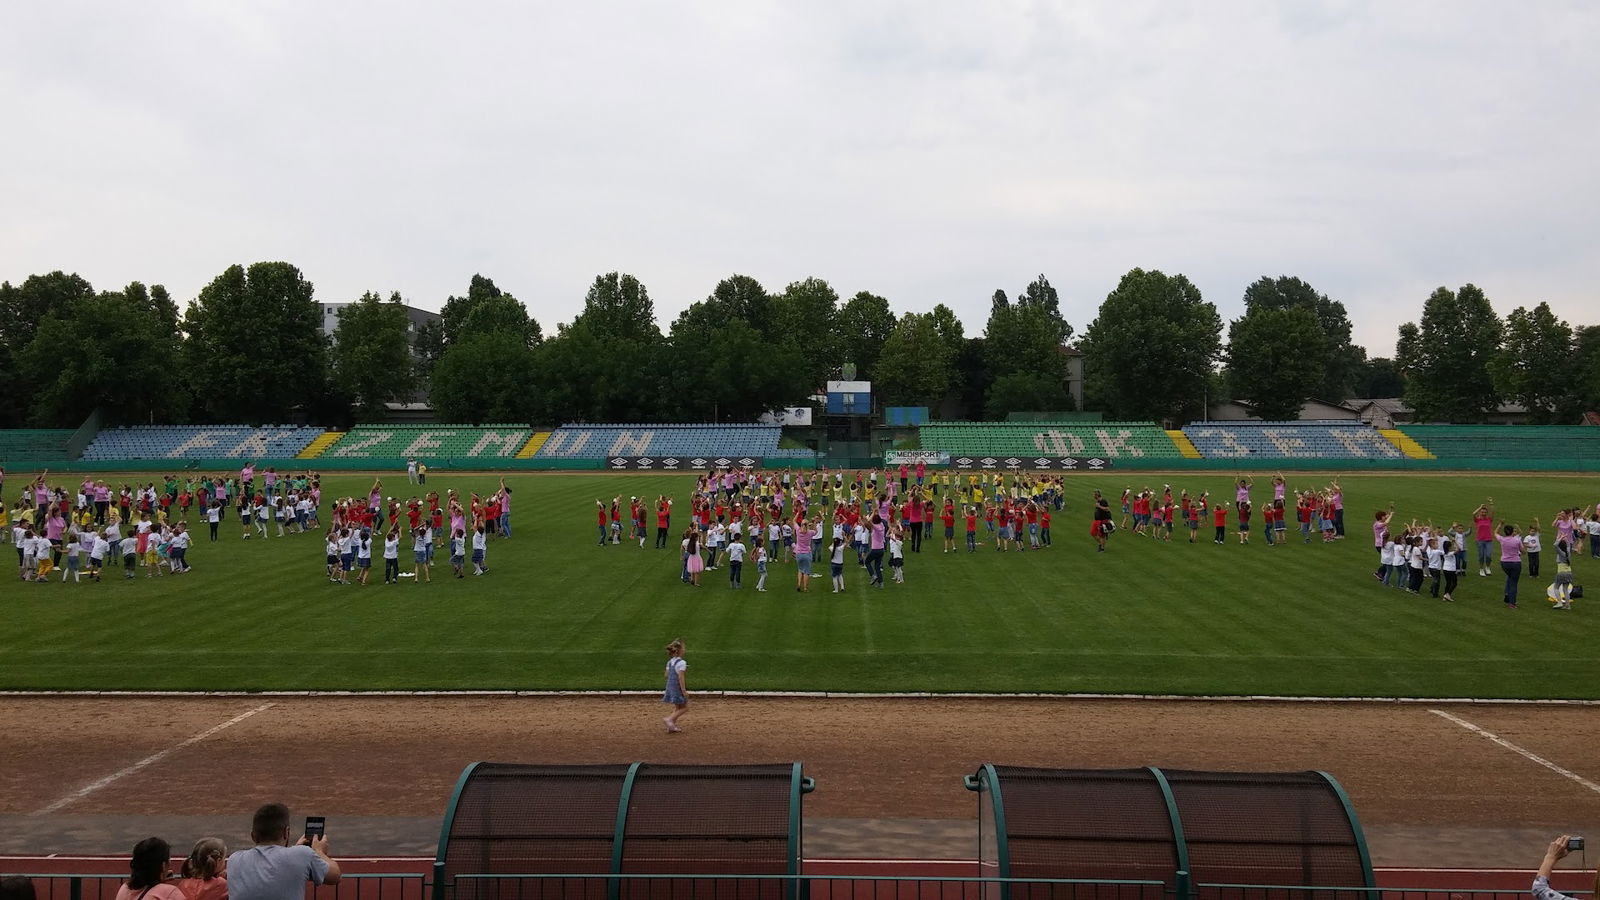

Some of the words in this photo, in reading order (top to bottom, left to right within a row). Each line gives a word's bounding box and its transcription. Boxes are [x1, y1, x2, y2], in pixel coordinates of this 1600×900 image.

[166, 430, 293, 458] FK
[333, 430, 656, 458] ZEMUN
[1033, 429, 1145, 457] ФК
